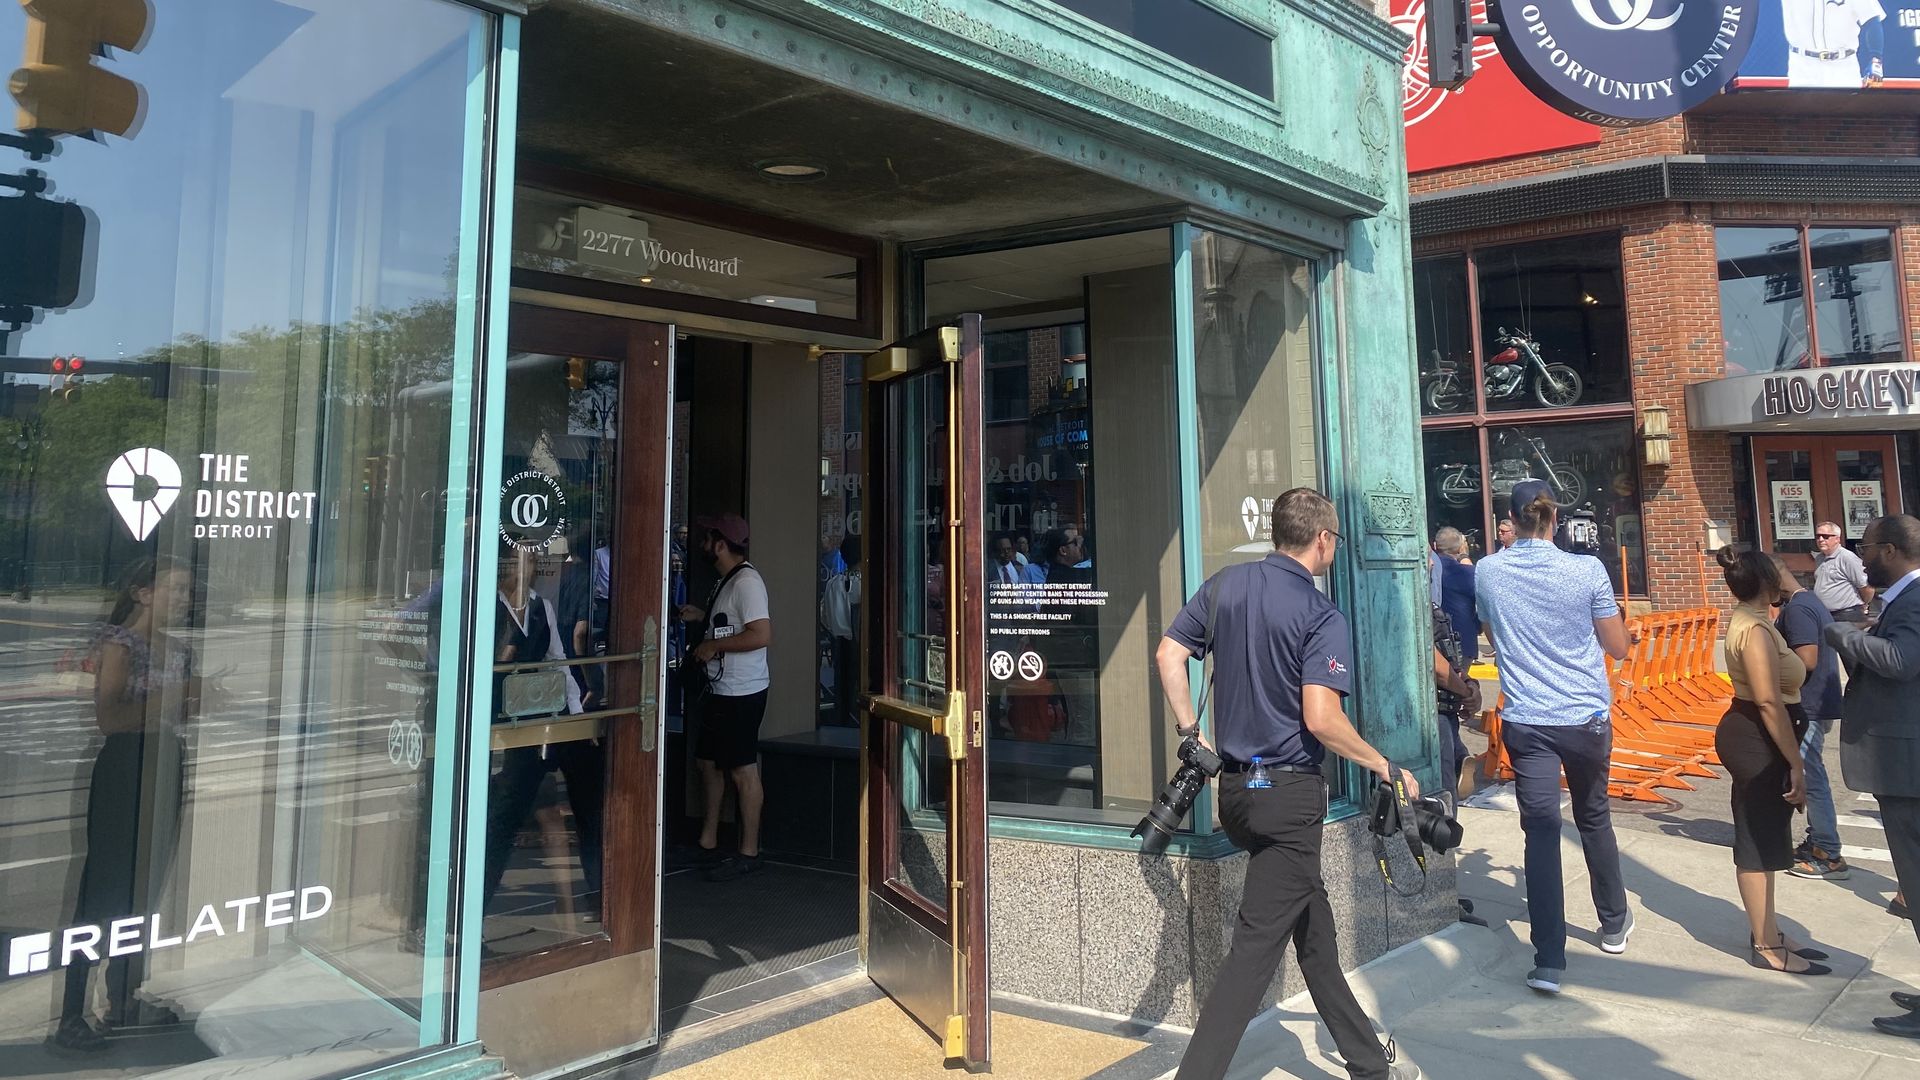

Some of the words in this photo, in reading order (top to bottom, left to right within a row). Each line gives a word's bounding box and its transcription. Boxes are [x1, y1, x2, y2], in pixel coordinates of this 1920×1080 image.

[1521, 4, 1674, 100] OPPORTUNITY
[1679, 4, 1742, 87] CENTER
[1574, 111, 1634, 126] JOBS
[582, 229, 635, 257] 2277
[640, 239, 739, 276] Woodward
[199, 453, 249, 482] THE
[507, 470, 542, 487] DISTRICT
[543, 475, 566, 506] DETROIT
[1780, 487, 1802, 496] KISS
[1850, 487, 1873, 496] KISS
[196, 489, 316, 519] DISTRICT
[194, 524, 273, 539] DETROIT
[543, 517, 566, 548] CENTER
[61, 885, 333, 967] RELATED
